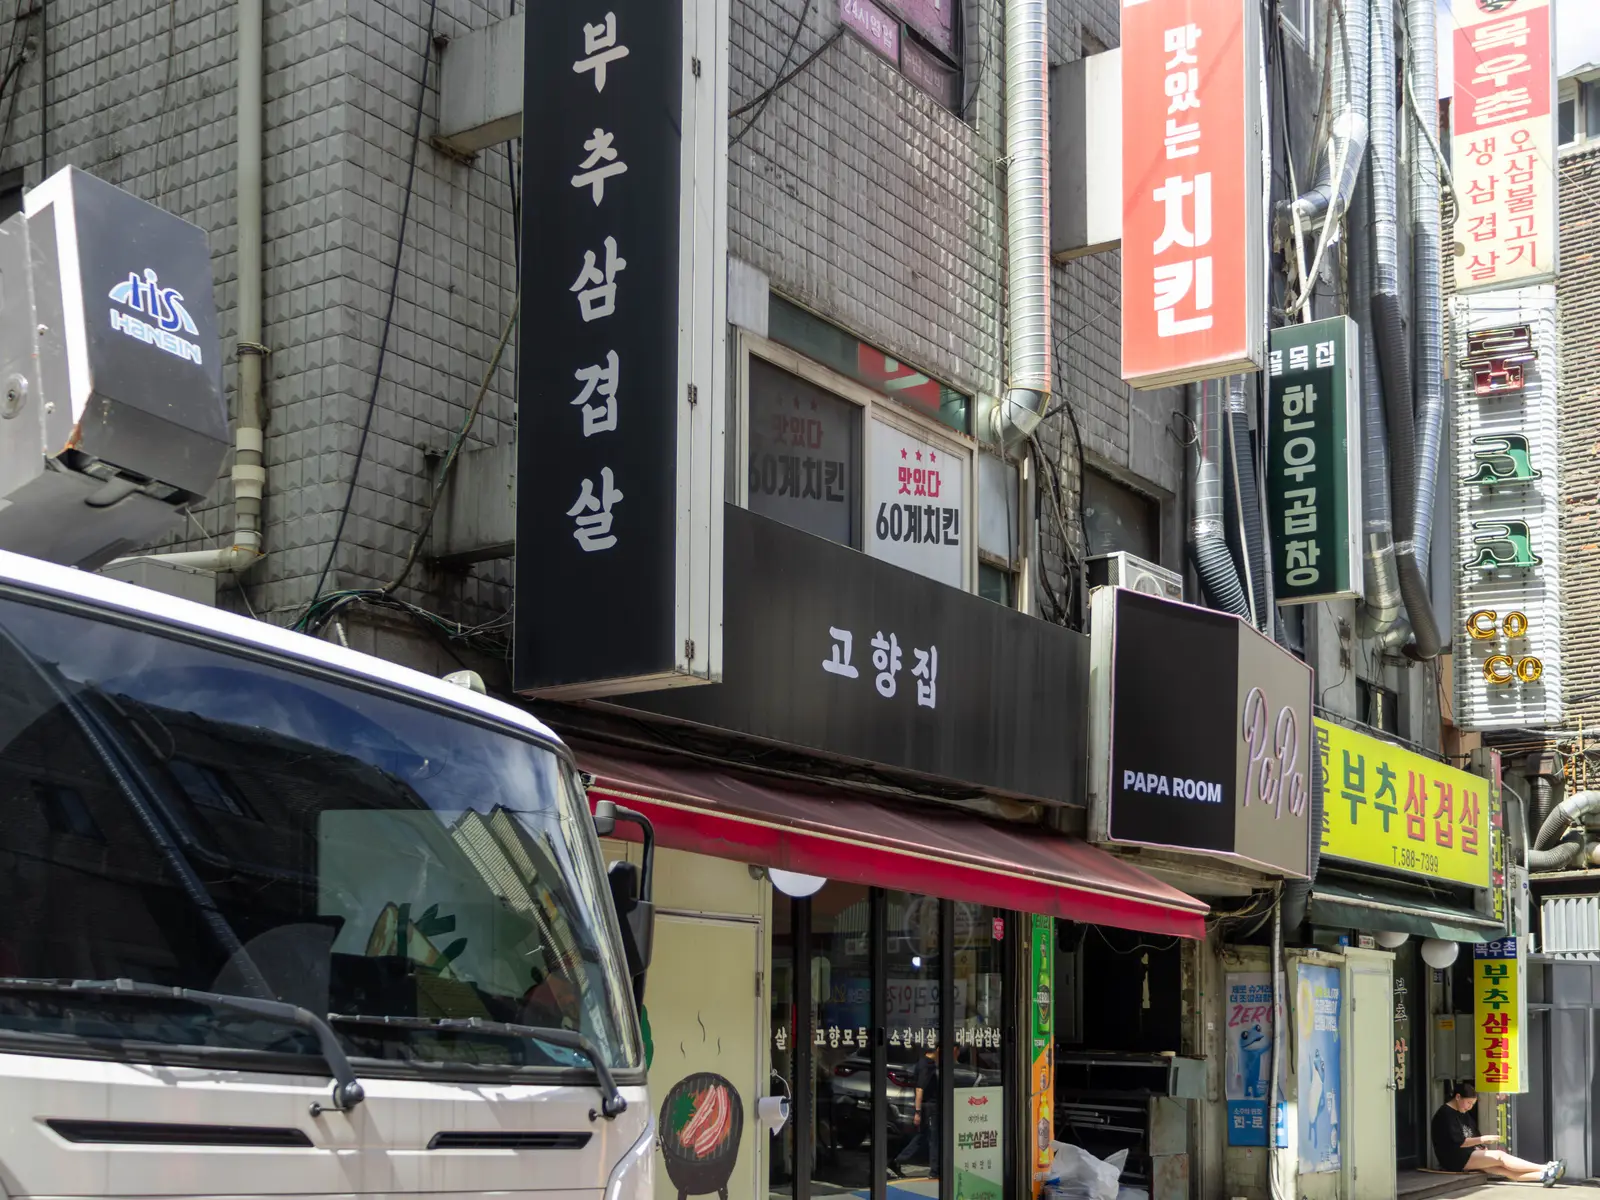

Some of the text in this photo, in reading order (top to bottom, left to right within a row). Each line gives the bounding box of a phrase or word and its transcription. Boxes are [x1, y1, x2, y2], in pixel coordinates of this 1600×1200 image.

[1164, 23, 1202, 160] 맛있는
[1471, 16, 1532, 125] 목우촌
[1465, 137, 1500, 281] 생삼겹살
[1503, 129, 1538, 267] 오삼불고기
[1153, 171, 1213, 338] 치킨
[566, 11, 630, 553] 부추삼겹살
[1269, 340, 1335, 376] 골목집
[773, 412, 824, 450] 맛있다
[749, 453, 845, 503] 60계치킨
[898, 467, 942, 498] 맛있다
[1282, 384, 1321, 587] 한우곱창
[876, 502, 959, 546] 60계치킨
[821, 626, 939, 709] 고향집
[1123, 768, 1223, 804] PAPA ROOM
[1340, 749, 1480, 856] 부추삼겹살
[1391, 845, 1439, 874] T.588-7399
[1475, 940, 1516, 957] 목우촌
[774, 1026, 788, 1050] 살
[813, 1024, 869, 1049] 고향모듬
[889, 1026, 937, 1049] 소갈비살
[955, 1026, 1001, 1049] 대패삼겹살
[1481, 964, 1512, 1084] 부추삼겹살
[958, 1130, 998, 1150] 부추삼겹살
